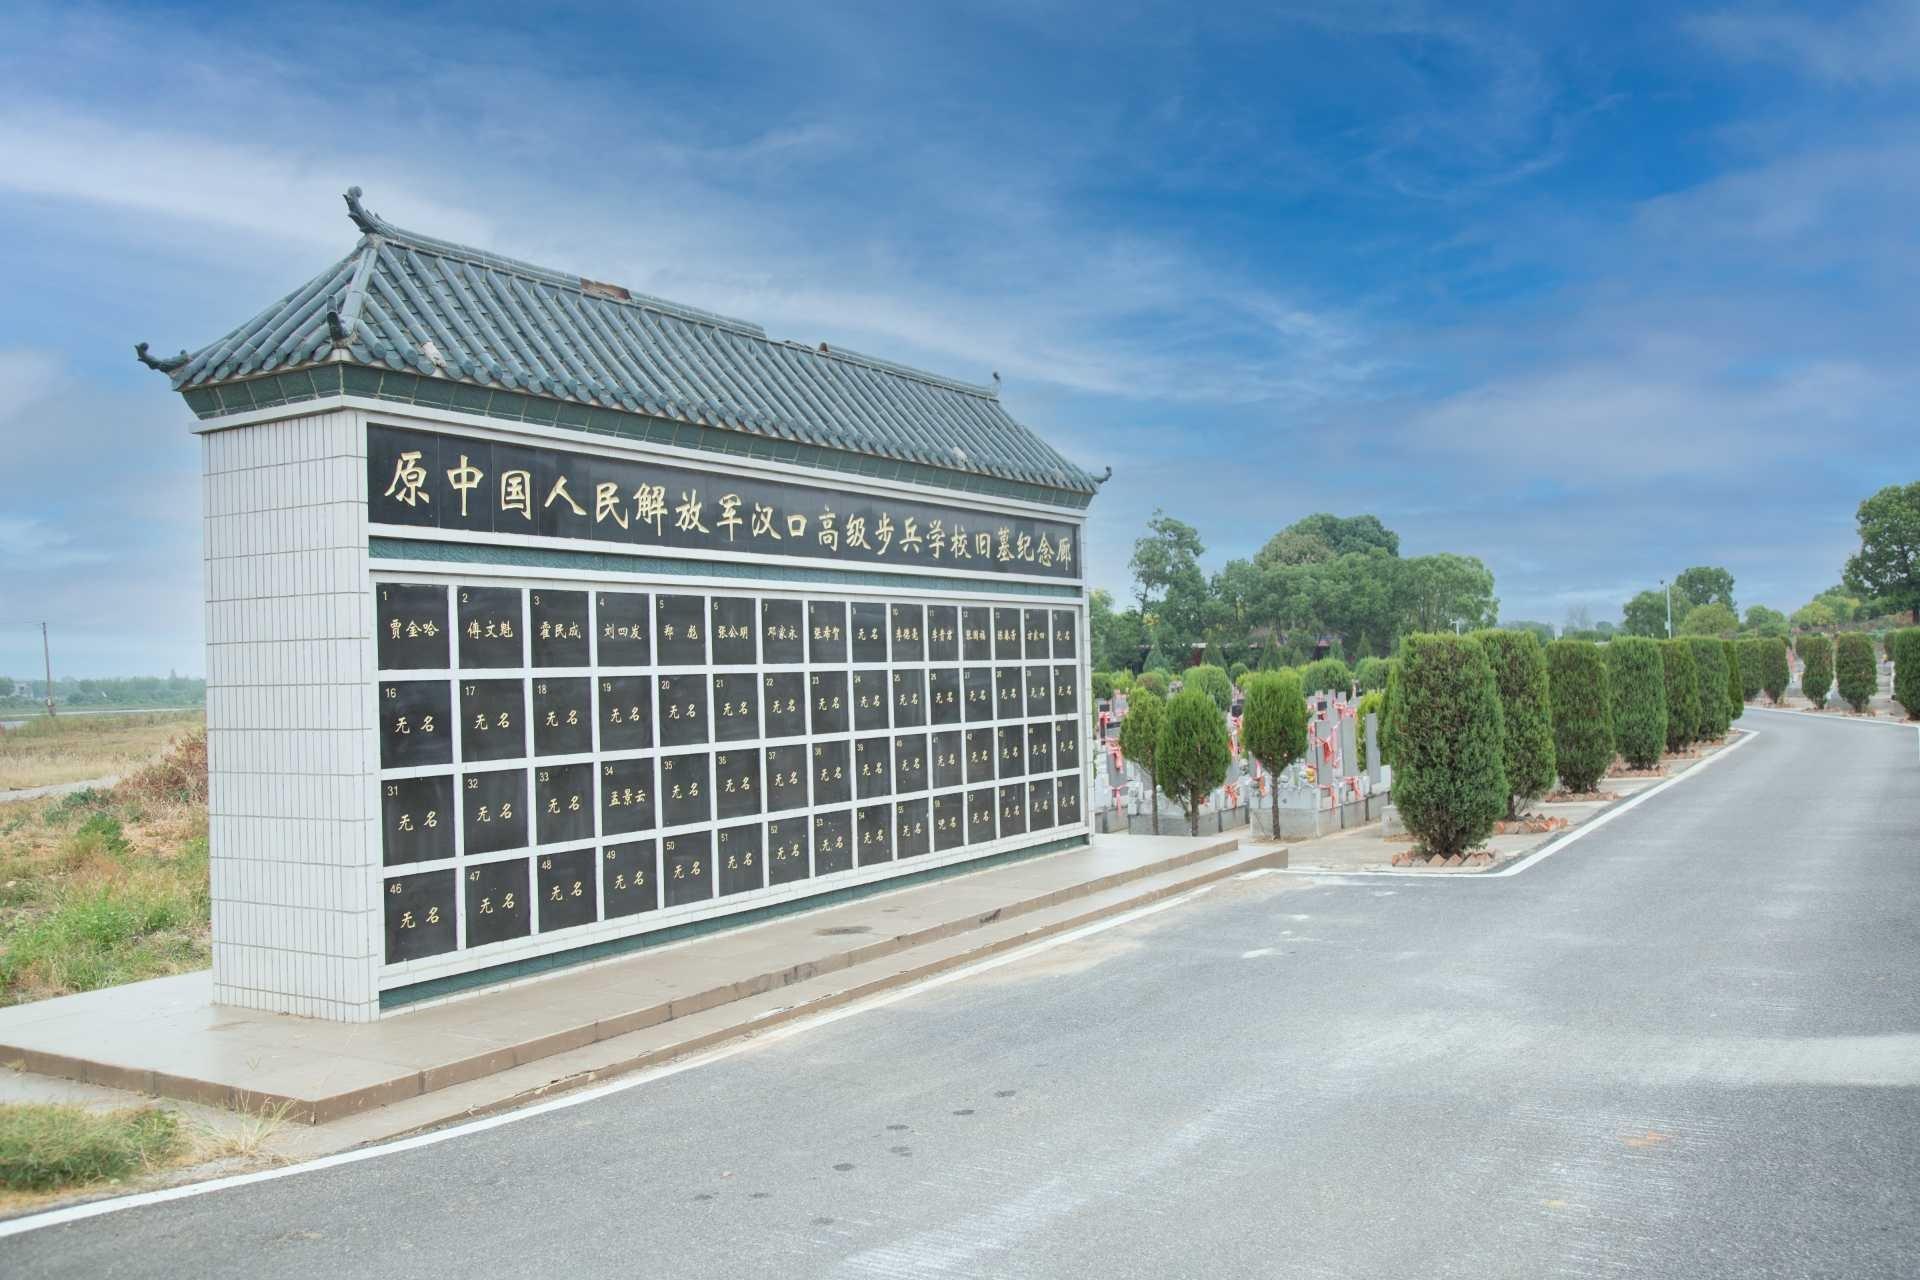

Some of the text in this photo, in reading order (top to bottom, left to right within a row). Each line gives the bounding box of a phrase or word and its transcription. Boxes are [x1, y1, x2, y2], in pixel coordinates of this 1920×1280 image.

[383, 591, 388, 601] 1
[462, 593, 468, 603] 2
[534, 596, 539, 605] 3
[600, 598, 604, 607] 4
[660, 600, 664, 608] 5
[540, 620, 581, 639] 霍民成
[858, 628, 878, 640] 无名
[538, 684, 547, 694] 18
[603, 682, 612, 692] 19
[662, 680, 670, 689] 20
[716, 680, 723, 688] 21
[385, 688, 396, 698] 16
[465, 686, 475, 696] 17
[772, 699, 795, 714] 无名
[819, 697, 840, 710] 无名
[860, 695, 880, 708] 无名
[610, 706, 639, 723] 无名
[669, 704, 696, 719] 无名
[723, 701, 748, 716] 无名
[395, 715, 434, 734] 无名
[474, 712, 510, 730] 无名
[546, 710, 578, 726] 无名
[604, 766, 613, 775] 34
[664, 761, 672, 770] 35
[862, 762, 882, 776] 无名
[540, 772, 549, 782] 33
[775, 771, 798, 786] 无名
[821, 767, 842, 781] 无名
[468, 778, 478, 789] 32
[725, 776, 750, 792] 无名
[388, 786, 397, 796] 31
[672, 782, 698, 799] 无名
[548, 796, 580, 814] 无名
[477, 803, 512, 822] 无名
[398, 811, 437, 831] 无名
[721, 833, 728, 842] 51
[864, 829, 883, 844] 无名
[667, 841, 674, 850] 50
[820, 836, 843, 851] 无名
[606, 850, 616, 860] 49
[776, 844, 799, 860] 无名
[542, 860, 551, 870] 48
[728, 851, 752, 869] 无名
[469, 871, 480, 881] 47
[673, 861, 700, 879] 无名
[614, 870, 644, 889] 无名
[390, 883, 402, 894] 46
[550, 881, 582, 901] 无名
[480, 893, 514, 914] 无名
[400, 907, 440, 928] 无名
